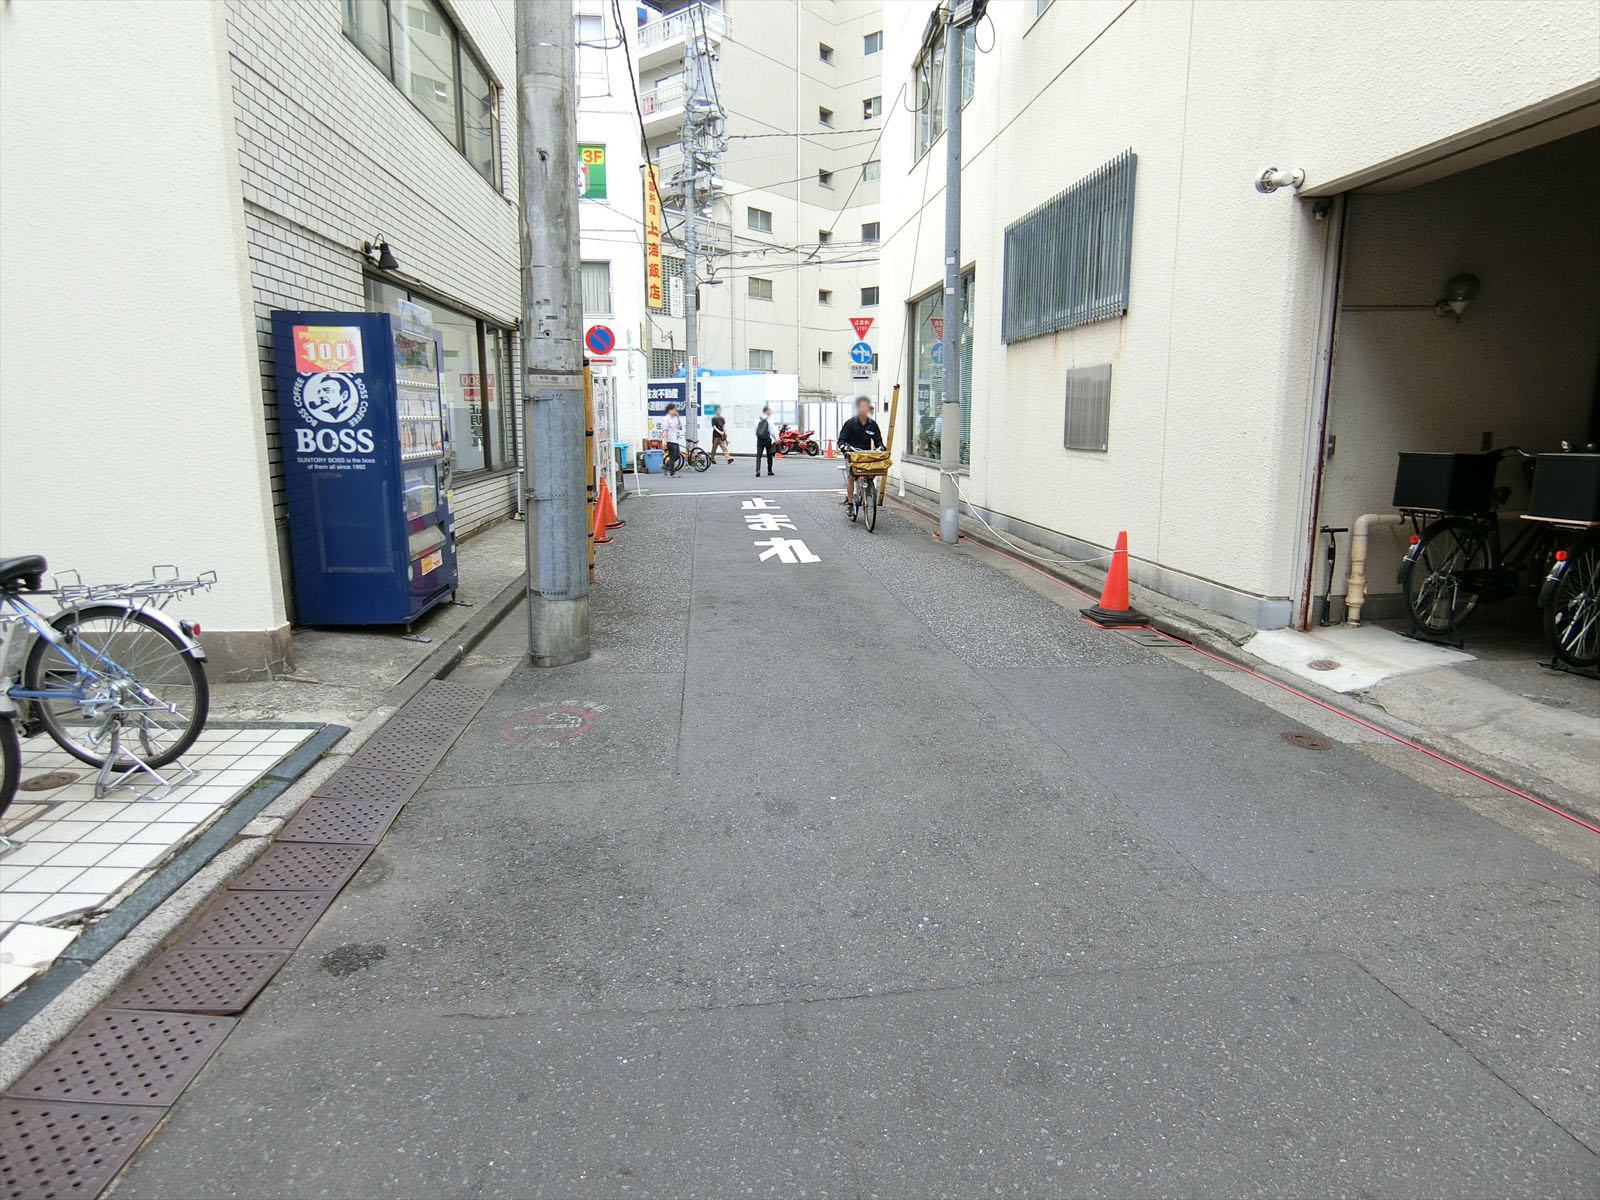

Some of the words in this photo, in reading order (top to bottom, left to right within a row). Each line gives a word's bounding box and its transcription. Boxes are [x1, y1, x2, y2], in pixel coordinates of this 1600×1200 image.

[583, 149, 603, 163] 3F
[293, 376, 305, 408] COFFEE
[354, 378, 369, 400] BOSS
[298, 407, 319, 428] BOSS
[349, 399, 369, 428] COFFEE
[295, 428, 375, 454] BOSS
[740, 497, 822, 564] 止まれ
